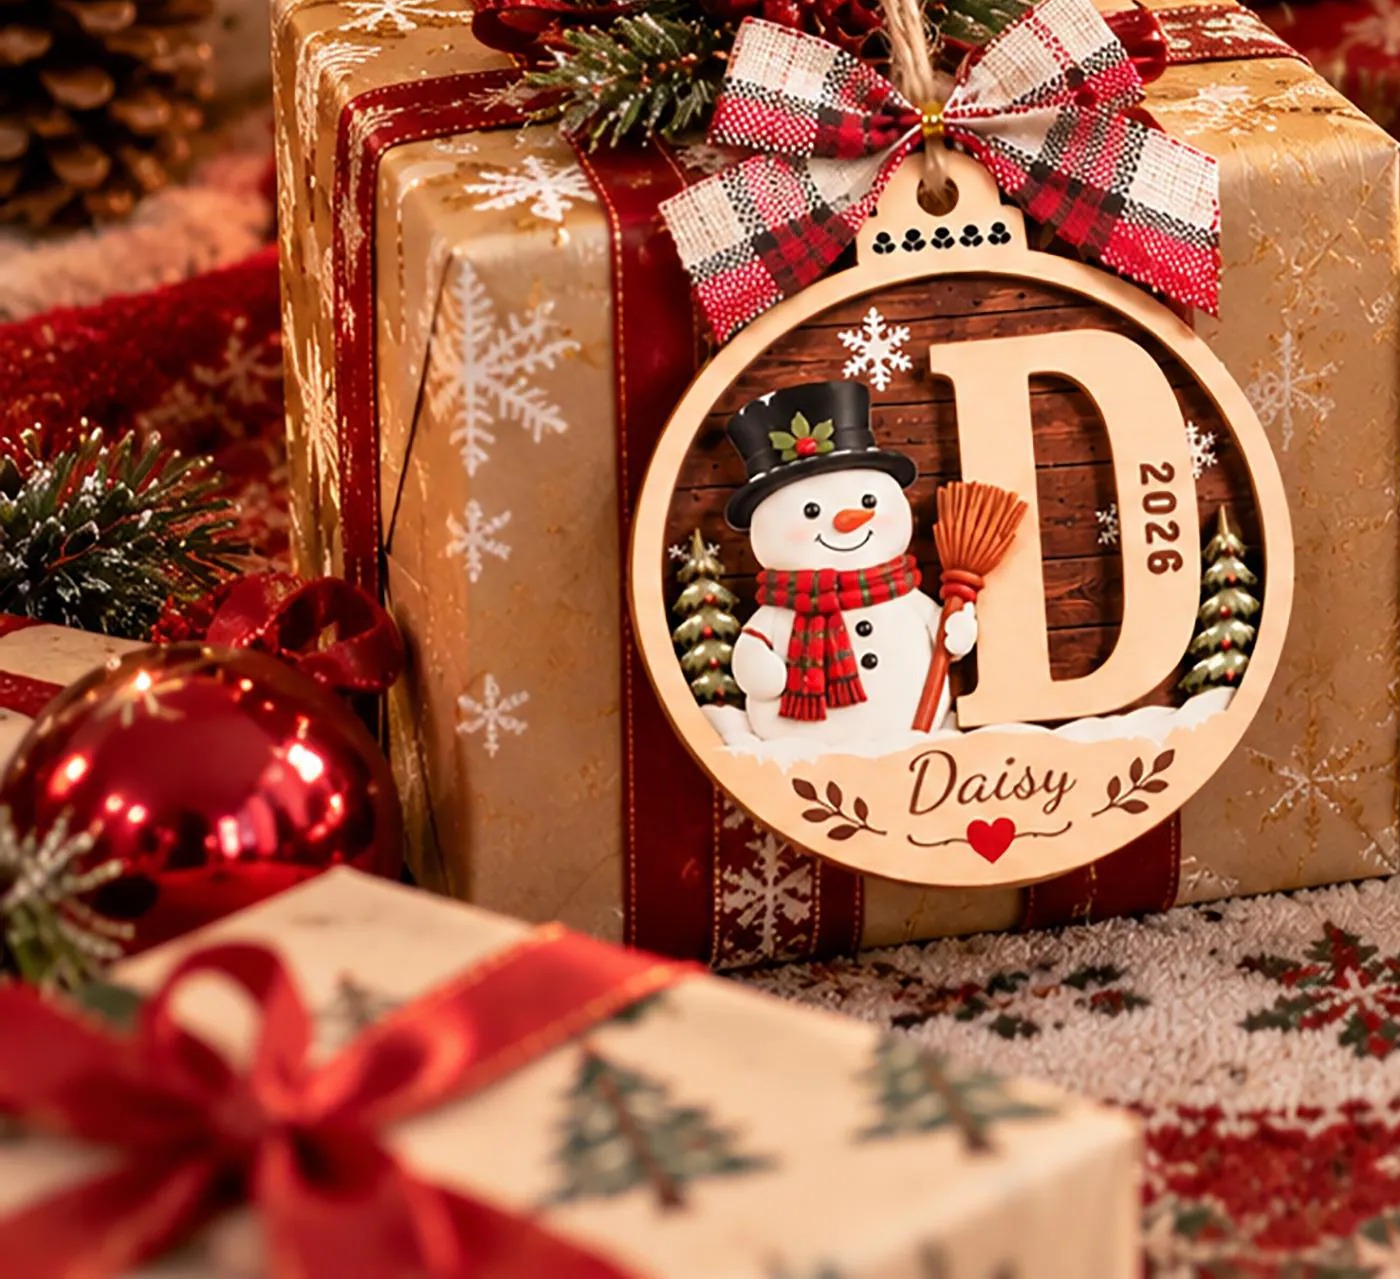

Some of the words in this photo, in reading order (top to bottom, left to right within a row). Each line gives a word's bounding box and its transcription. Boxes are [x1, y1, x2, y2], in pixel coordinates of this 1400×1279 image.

[929, 328, 1202, 728] D
[1138, 461, 1184, 576] 2026
[908, 749, 1077, 816] Daisy
